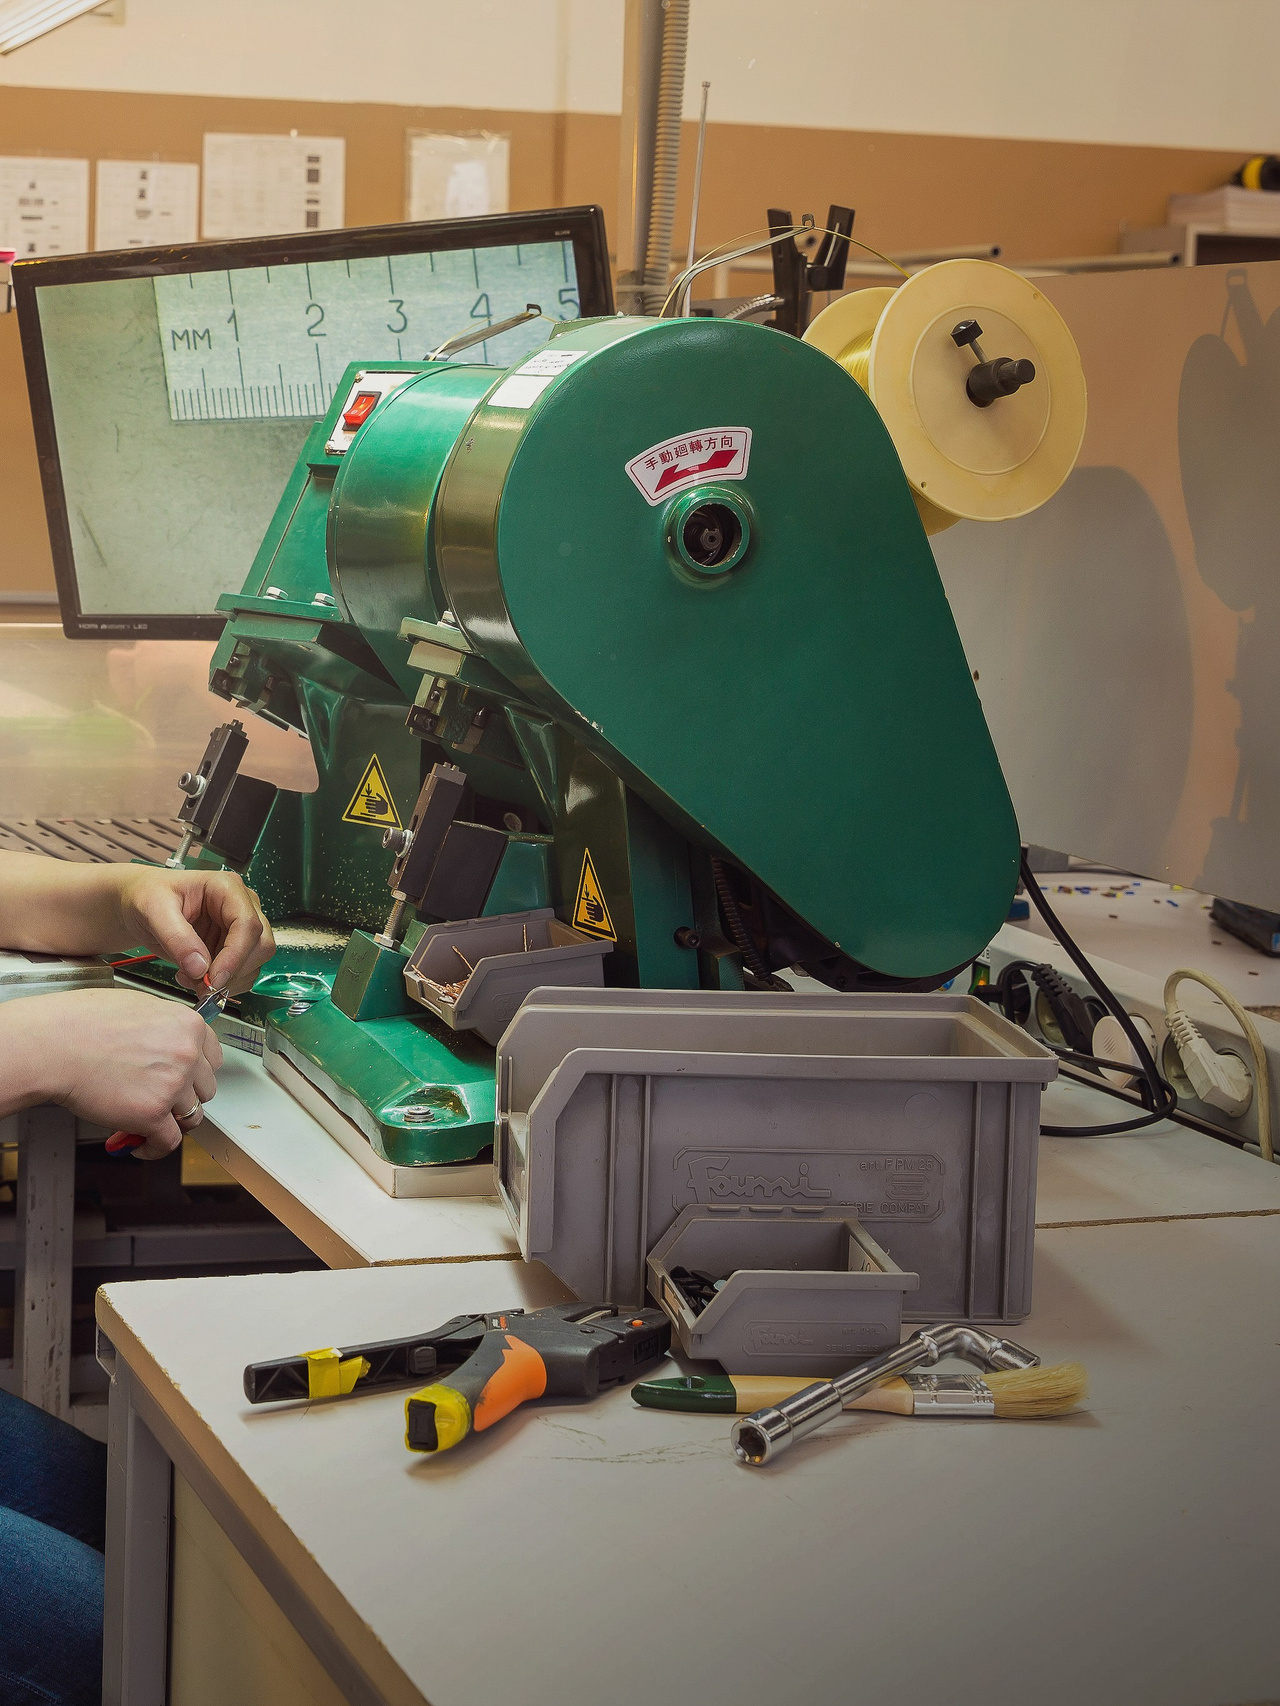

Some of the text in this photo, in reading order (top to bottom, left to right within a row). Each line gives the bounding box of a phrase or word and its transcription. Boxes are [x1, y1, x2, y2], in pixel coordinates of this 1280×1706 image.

[227, 308, 239, 343] 1
[305, 304, 327, 338] 2
[386, 299, 409, 335] 3
[470, 292, 492, 327] 4
[559, 287, 580, 320] 5
[917, 1158, 933, 1171] 25
[881, 1202, 930, 1214] COMPAT
